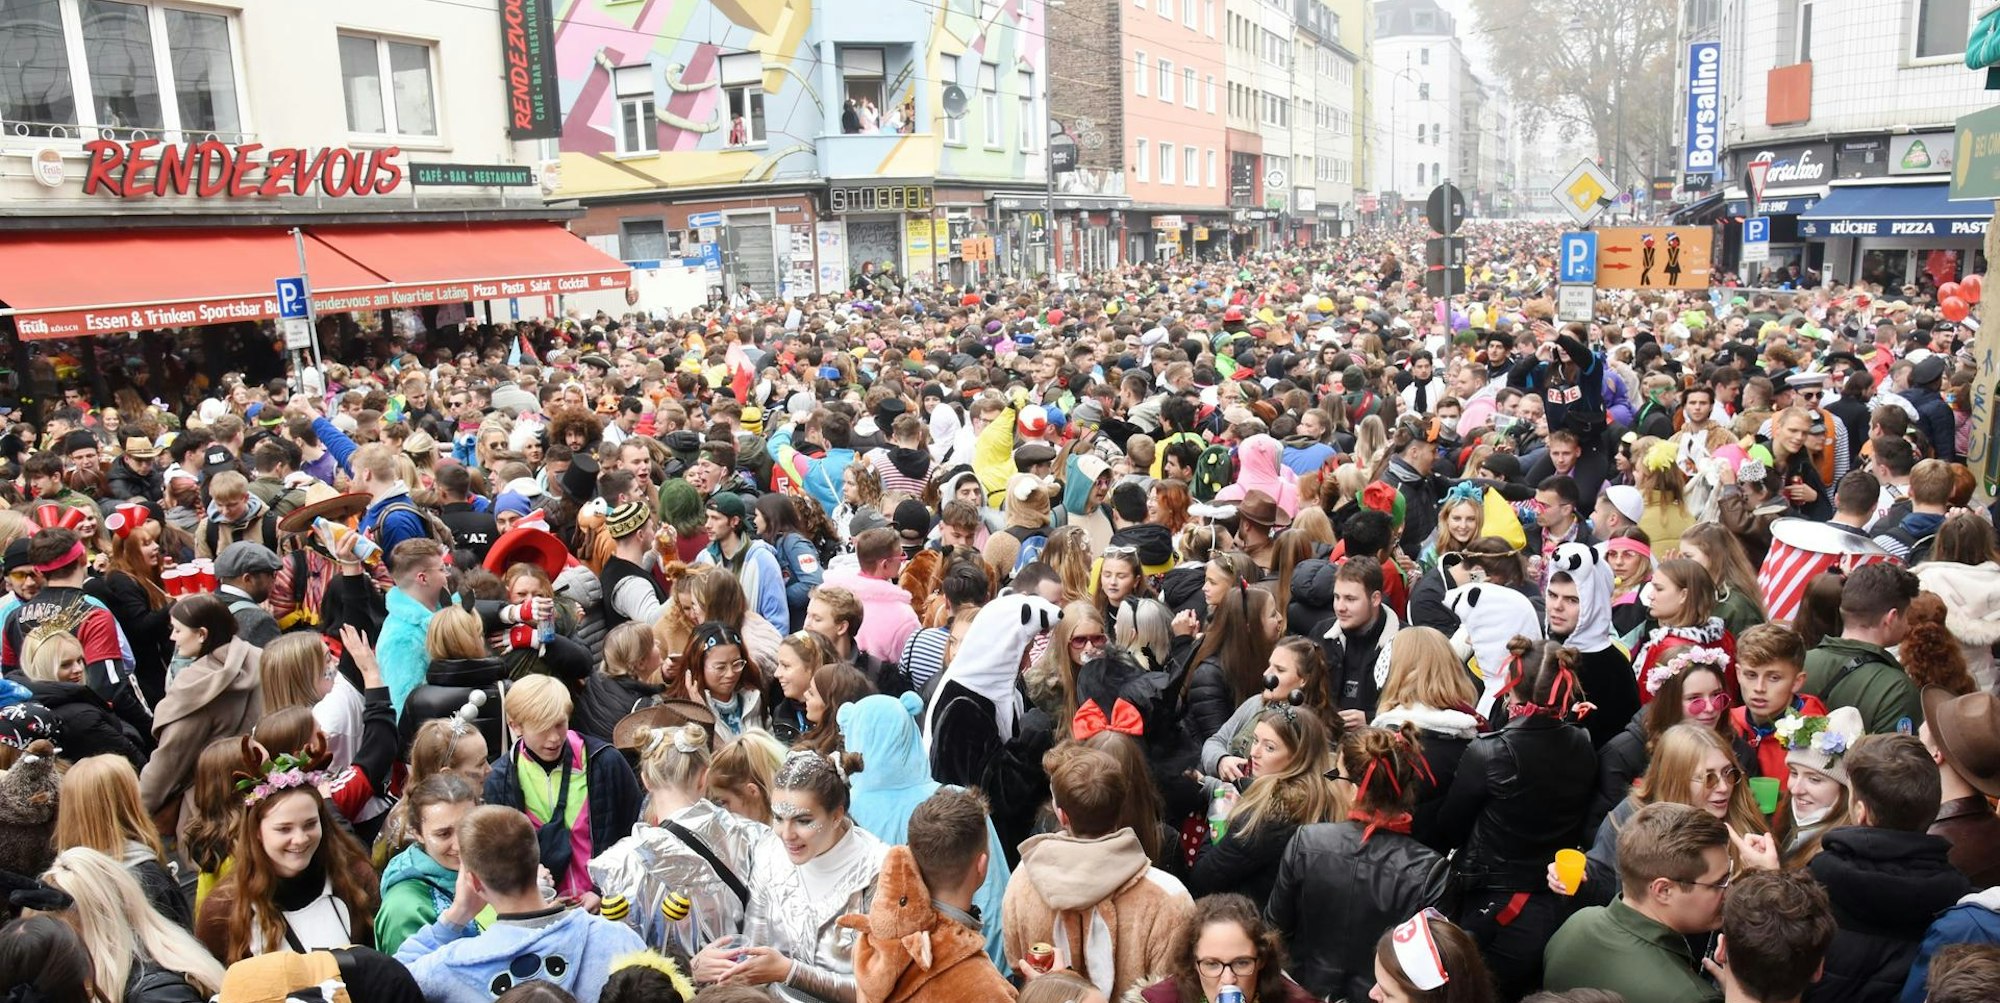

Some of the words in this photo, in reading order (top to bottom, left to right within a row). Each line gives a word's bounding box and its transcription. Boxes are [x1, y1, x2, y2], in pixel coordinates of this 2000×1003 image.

[526, 0, 540, 54] RESTAURA
[532, 64, 543, 85] BAR
[533, 95, 545, 120] CAFÉ
[1689, 47, 1718, 167] Borsalino
[1974, 135, 1986, 158] BEI
[1987, 131, 2000, 156] OM
[82, 138, 402, 199] RENDEZVOUS
[419, 168, 442, 183] CAFÉ
[449, 170, 467, 183] BAR
[474, 171, 527, 183] RESTAURANT
[1686, 174, 1708, 187] sky
[833, 187, 930, 209] STIEFEL
[1749, 221, 1763, 240] P
[1830, 219, 1877, 234] KÜCHE
[1891, 222, 1935, 234] PIZZA
[1951, 222, 1988, 234] PAST
[1568, 239, 1588, 276] P
[19, 318, 48, 334] früh
[85, 314, 128, 330] Essen
[131, 311, 143, 327] &
[145, 308, 195, 326] Trinken
[200, 302, 260, 322] Sportsbar
[315, 296, 371, 310] endezvous
[374, 294, 389, 305] am
[391, 288, 433, 304] Kwartier
[436, 285, 469, 301] Latäng
[473, 284, 497, 297] Pizza
[501, 281, 525, 294] Pasta
[530, 278, 551, 292] Salat
[558, 276, 589, 290] Cocktail
[280, 283, 298, 313] P
